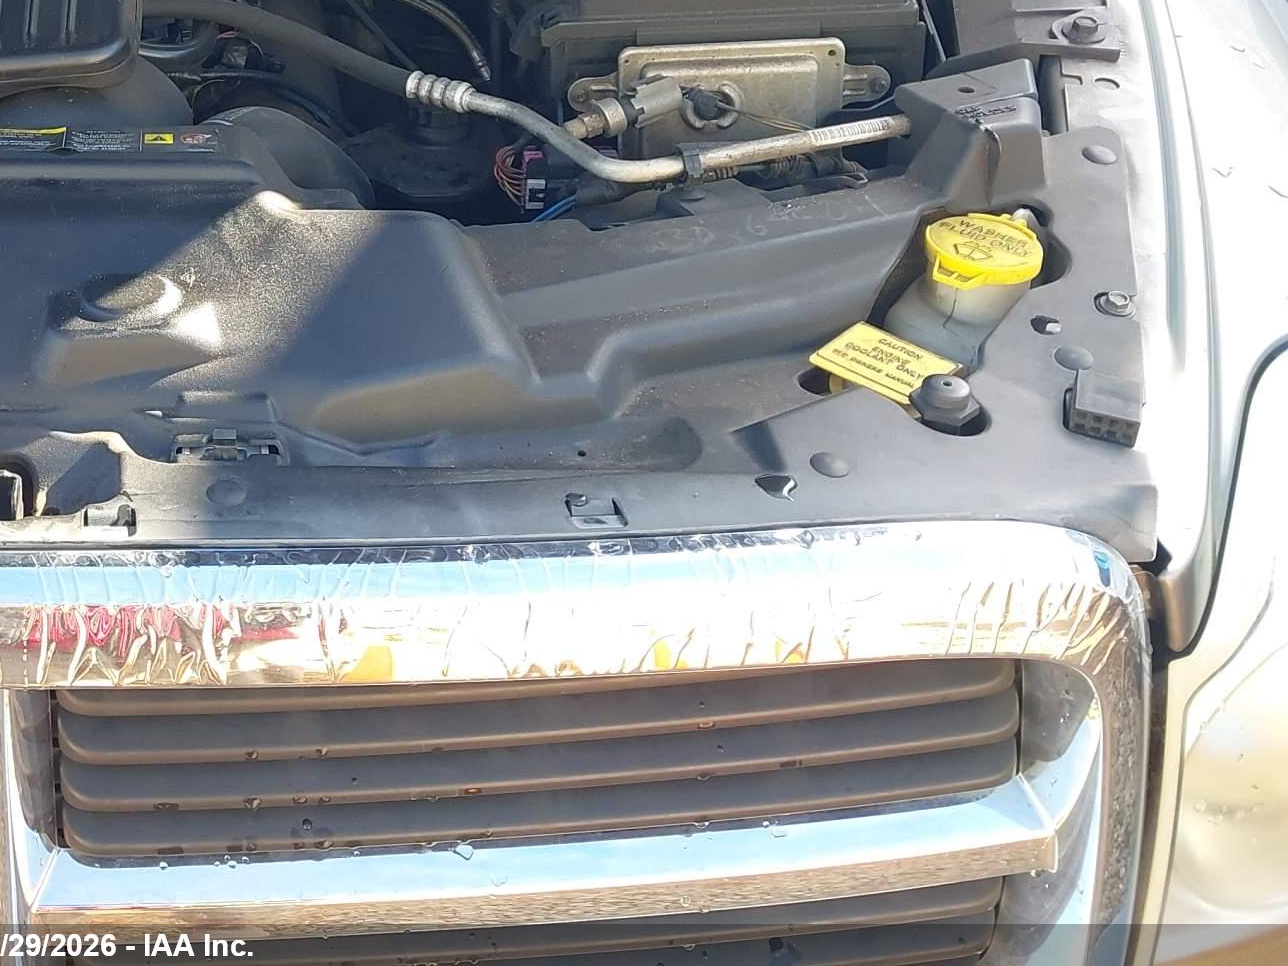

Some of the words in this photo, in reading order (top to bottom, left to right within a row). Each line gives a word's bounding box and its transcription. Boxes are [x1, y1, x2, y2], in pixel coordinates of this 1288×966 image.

[939, 221, 986, 242] FLUID
[990, 239, 1033, 258] ONLY
[959, 219, 1029, 248] WASHER
[871, 346, 912, 365] ENGINE
[877, 338, 924, 360] CAUTION
